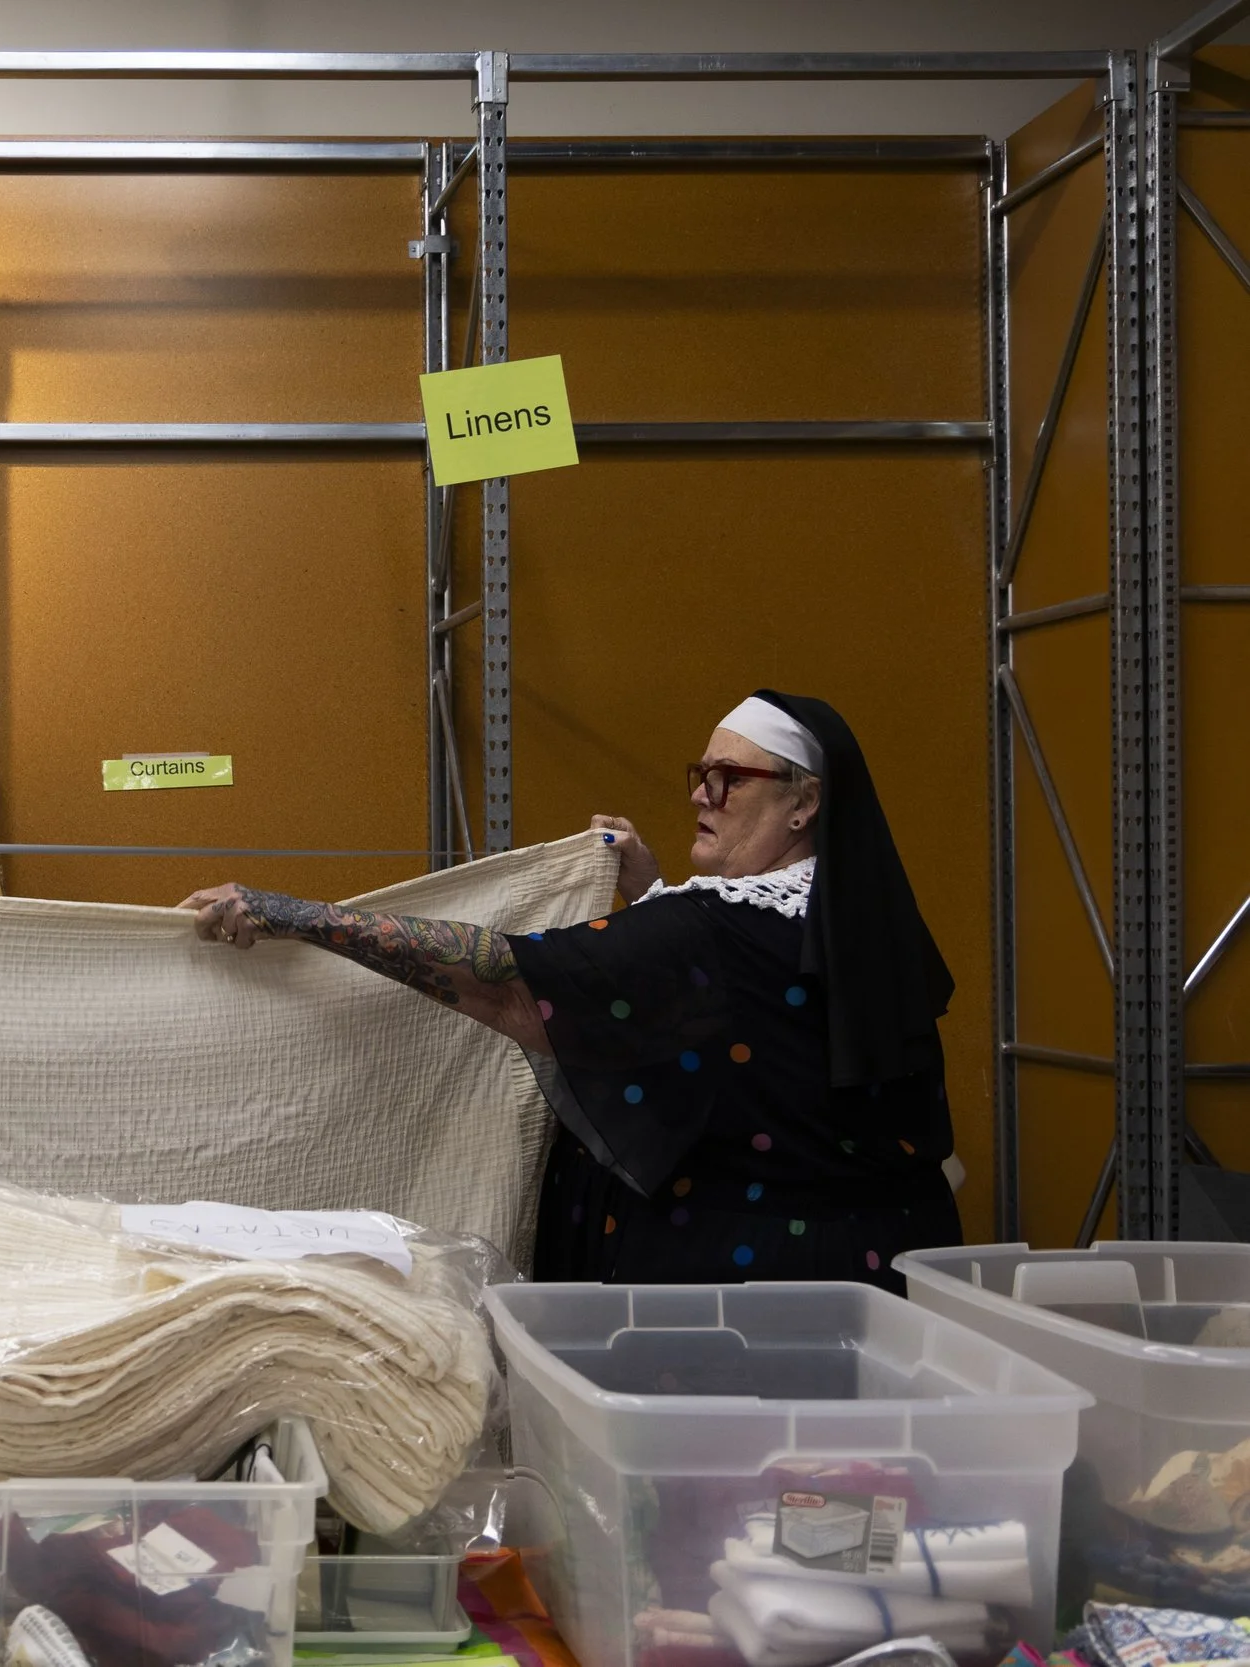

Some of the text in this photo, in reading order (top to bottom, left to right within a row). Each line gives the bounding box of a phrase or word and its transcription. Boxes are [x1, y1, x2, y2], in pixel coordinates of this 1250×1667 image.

[445, 404, 552, 440] Linens
[130, 759, 205, 777] Curtains
[149, 1218, 388, 1246] CURTAINS
